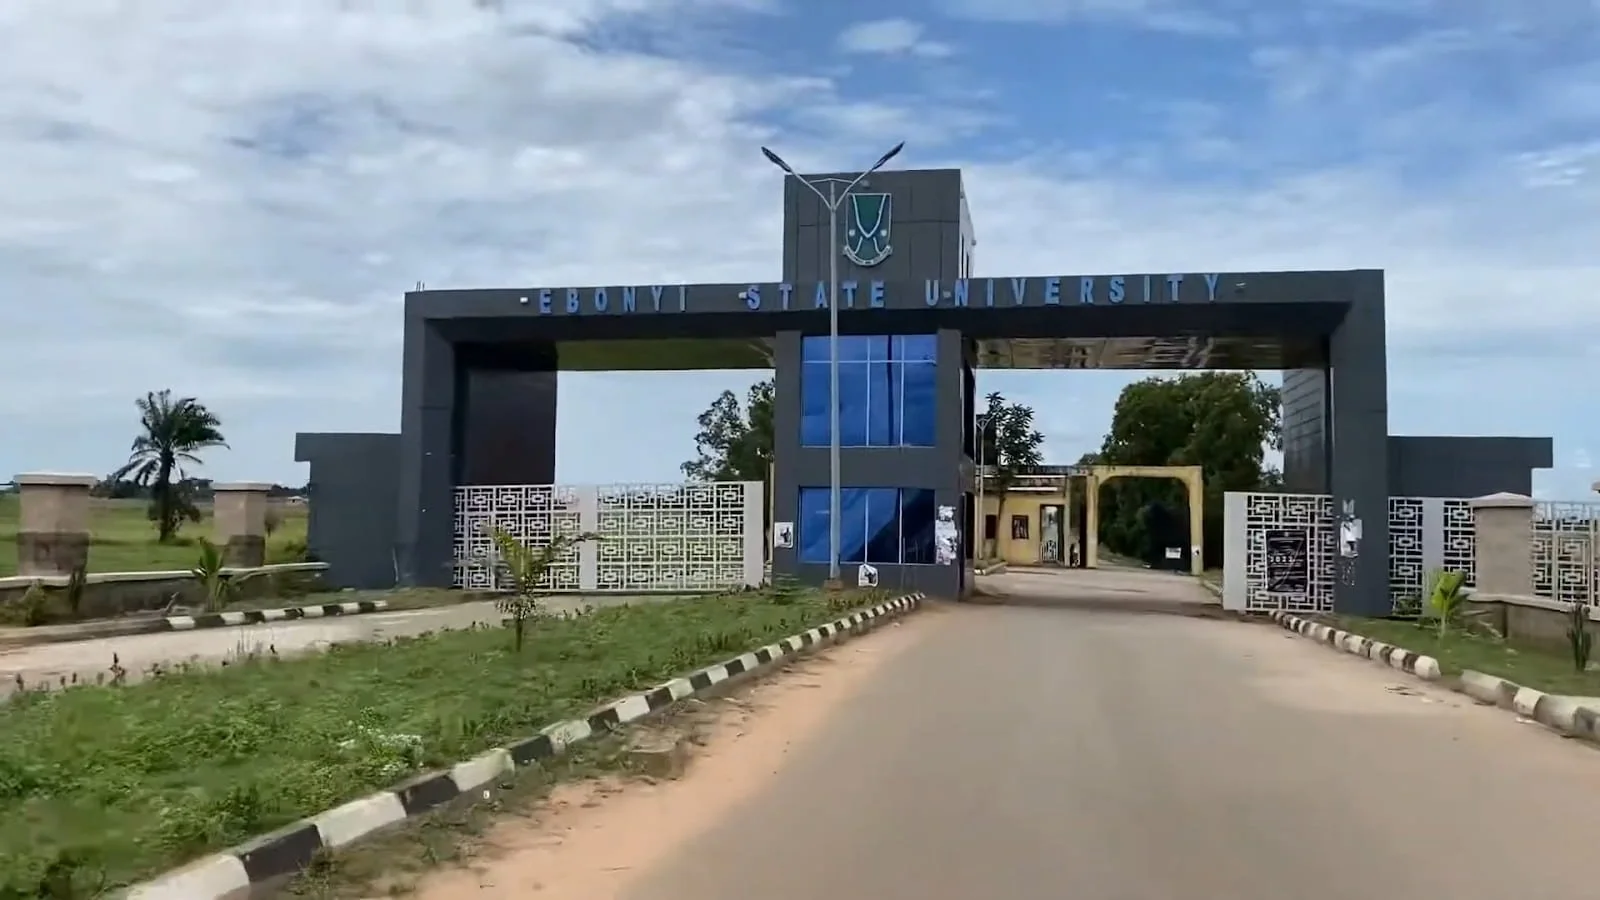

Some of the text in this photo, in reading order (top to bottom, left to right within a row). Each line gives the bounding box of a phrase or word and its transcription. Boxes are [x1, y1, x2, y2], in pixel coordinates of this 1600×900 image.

[538, 273, 1221, 314] EBONYI STATE UNIVERSITY
